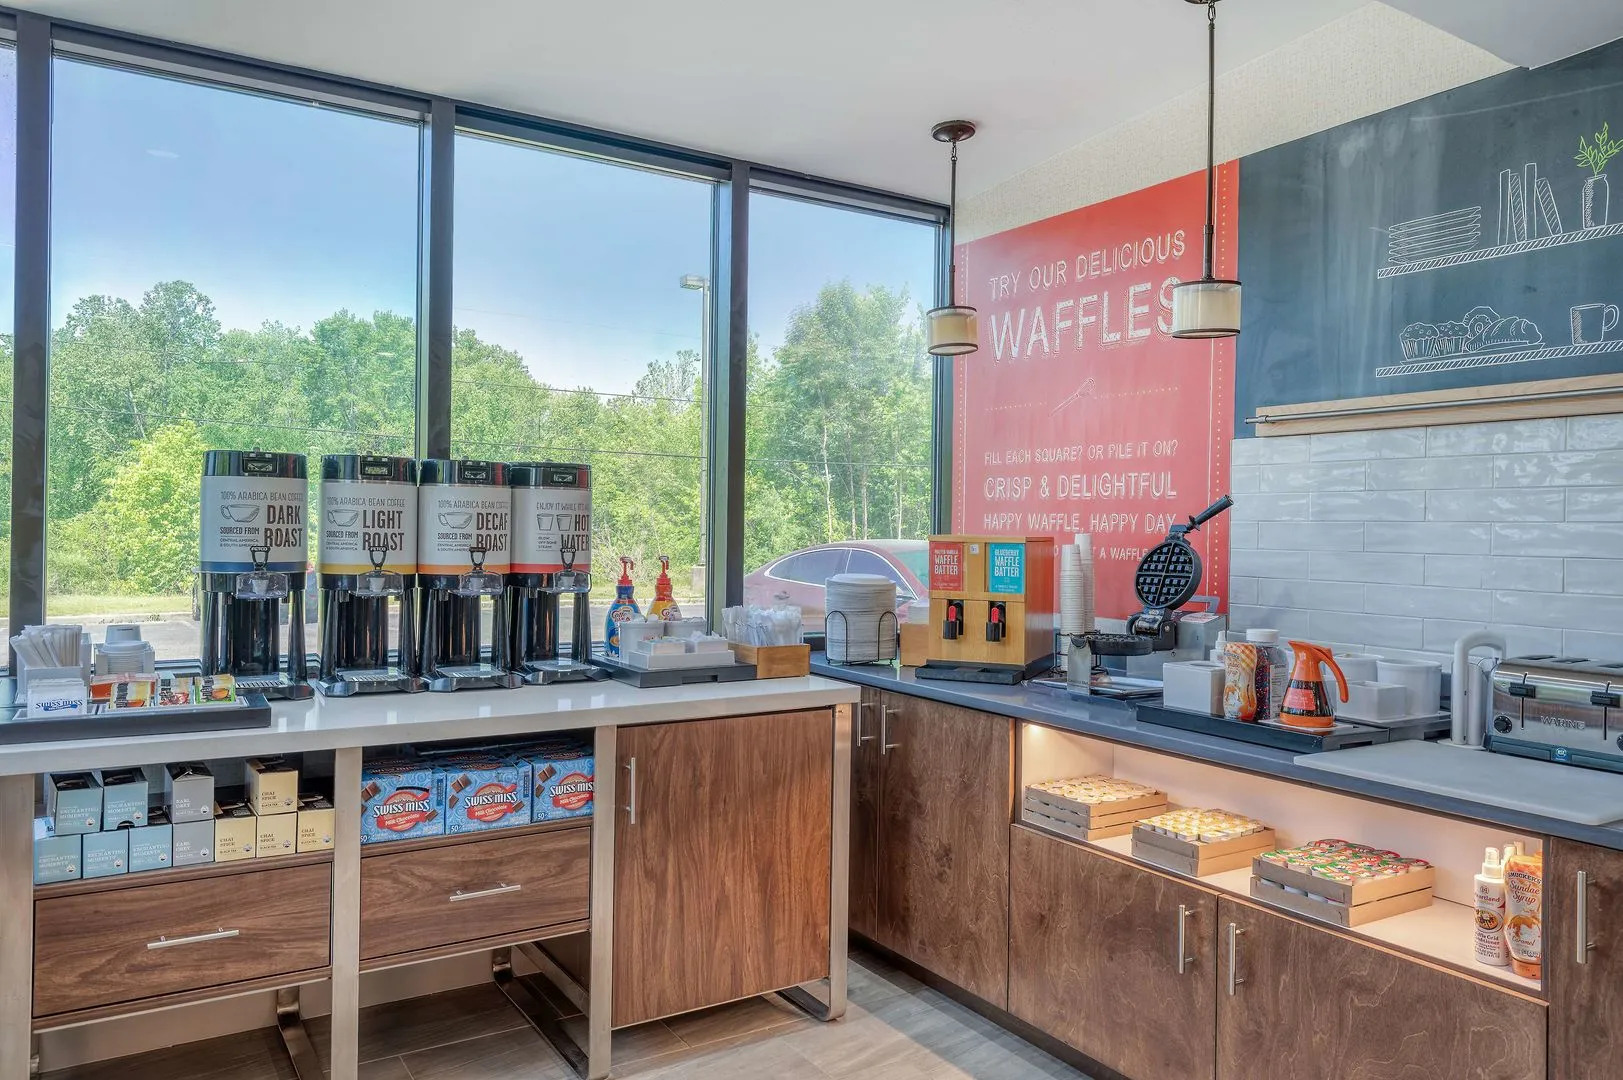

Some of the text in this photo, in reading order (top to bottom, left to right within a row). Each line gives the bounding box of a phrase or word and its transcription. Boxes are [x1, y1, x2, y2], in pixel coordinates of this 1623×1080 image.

[989, 229, 1185, 300] TRY OUR DELICIOUS
[989, 276, 1181, 364] WAFFLES
[984, 440, 1179, 465] FILL EACH SQUARE? OR PILE IT ON?
[984, 471, 1177, 499] CRISP & DELIGHTFUL
[220, 491, 237, 500] 100%
[238, 491, 268, 501] ARABICA
[270, 492, 287, 501] BEAN
[340, 497, 366, 506] ARABICA
[368, 498, 385, 507] BEAN
[387, 498, 405, 508] COFFEE
[438, 500, 452, 509] 100%
[453, 500, 480, 509] ARABICA
[481, 501, 495, 509] BEAN
[536, 502, 554, 510] ENJOY
[555, 502, 560, 510] IT
[561, 503, 577, 511] WHILE
[266, 504, 301, 525] DARK
[362, 509, 403, 529] LIGHT
[476, 512, 508, 530] DECAF
[574, 514, 590, 531] HOT
[220, 526, 260, 535] SOURCED FROM
[984, 513, 1022, 531] HAPPY
[1090, 513, 1139, 532] HAPPY
[1145, 513, 1177, 533] DAY
[264, 528, 303, 548] ROAST
[326, 530, 344, 538] SOURCED
[362, 532, 404, 551] ROAST
[437, 532, 473, 540] SOURCED FROM
[476, 533, 508, 551] ROAST
[560, 534, 590, 551] WATER
[934, 555, 959, 565] WAFFLE
[1099, 547, 1107, 559] A
[994, 556, 1019, 567] WAFFLE
[934, 565, 959, 575] BATTER
[994, 567, 1019, 577] BATTER
[1540, 715, 1586, 730] WARING
[549, 781, 593, 797] SWISS MIS
[464, 791, 518, 808] SWISS MISS
[373, 799, 430, 818] SWISS MISS
[1510, 879, 1541, 895] Sundae
[1512, 890, 1537, 906] Syrup
